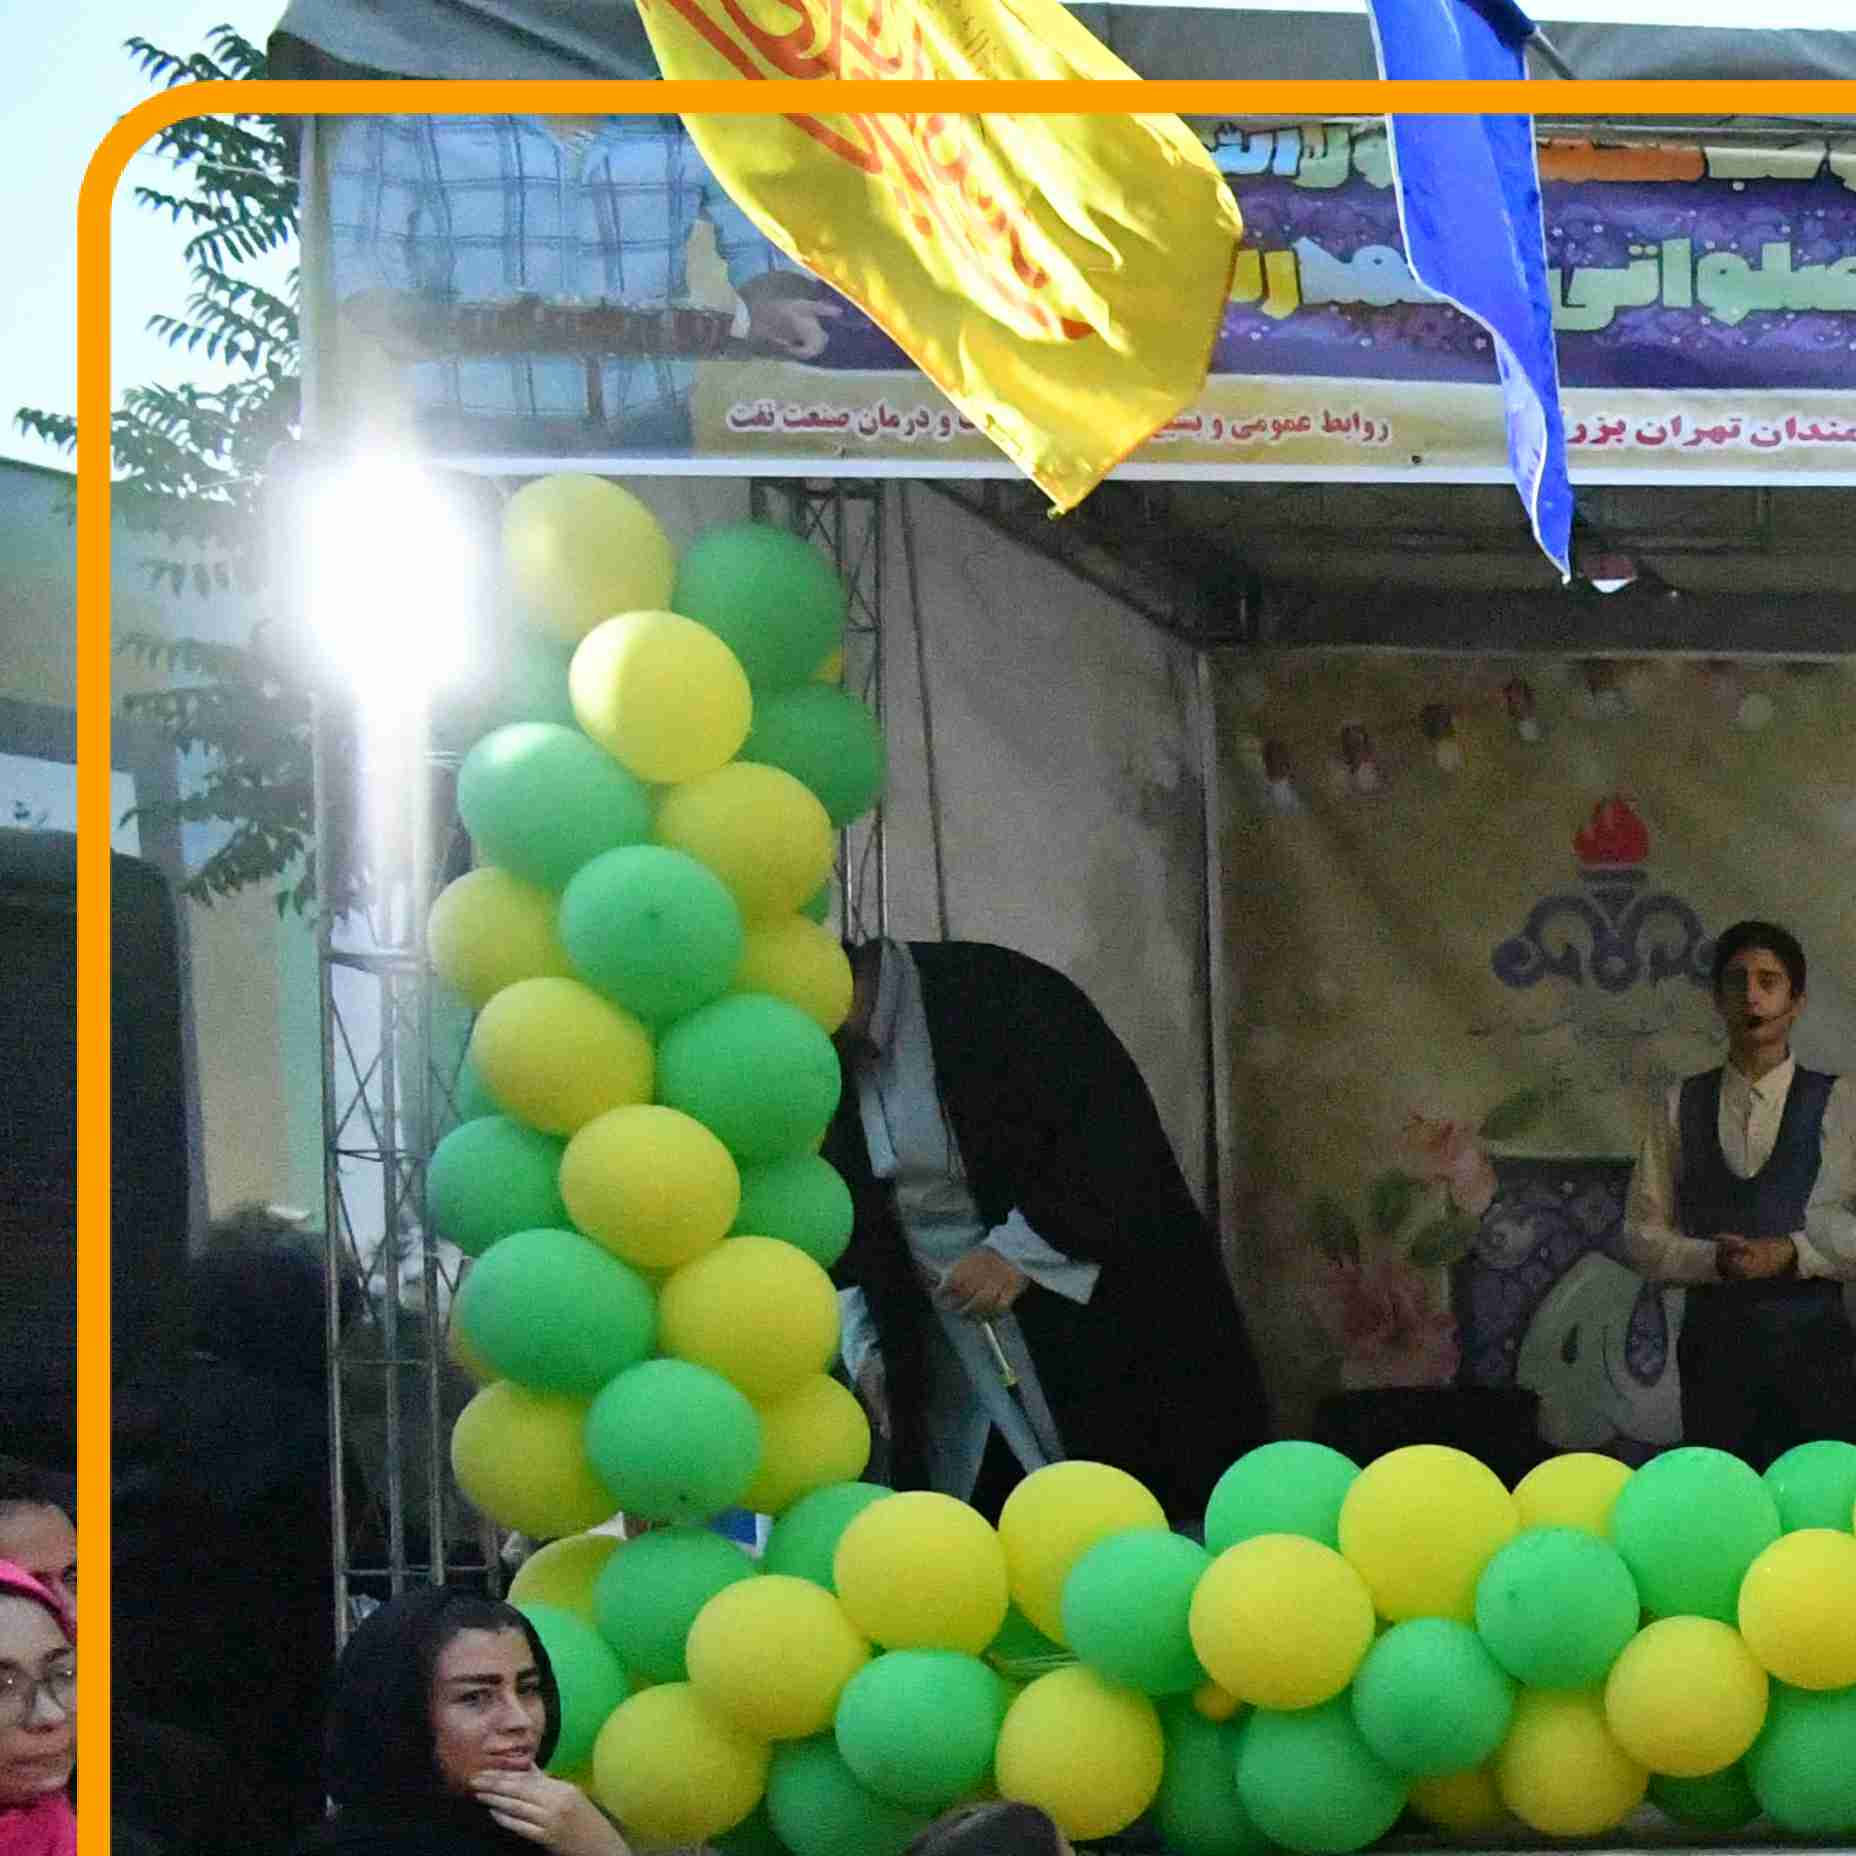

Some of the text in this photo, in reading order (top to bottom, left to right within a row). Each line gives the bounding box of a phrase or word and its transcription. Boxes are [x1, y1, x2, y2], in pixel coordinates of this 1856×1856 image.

[730, 401, 775, 429] نفت
[782, 405, 850, 429] صنعت
[858, 404, 929, 436] درمان
[1153, 410, 1389, 442] روابط عمومی و بسی
[1567, 416, 1627, 446] بزر
[1634, 415, 1742, 448] تهران
